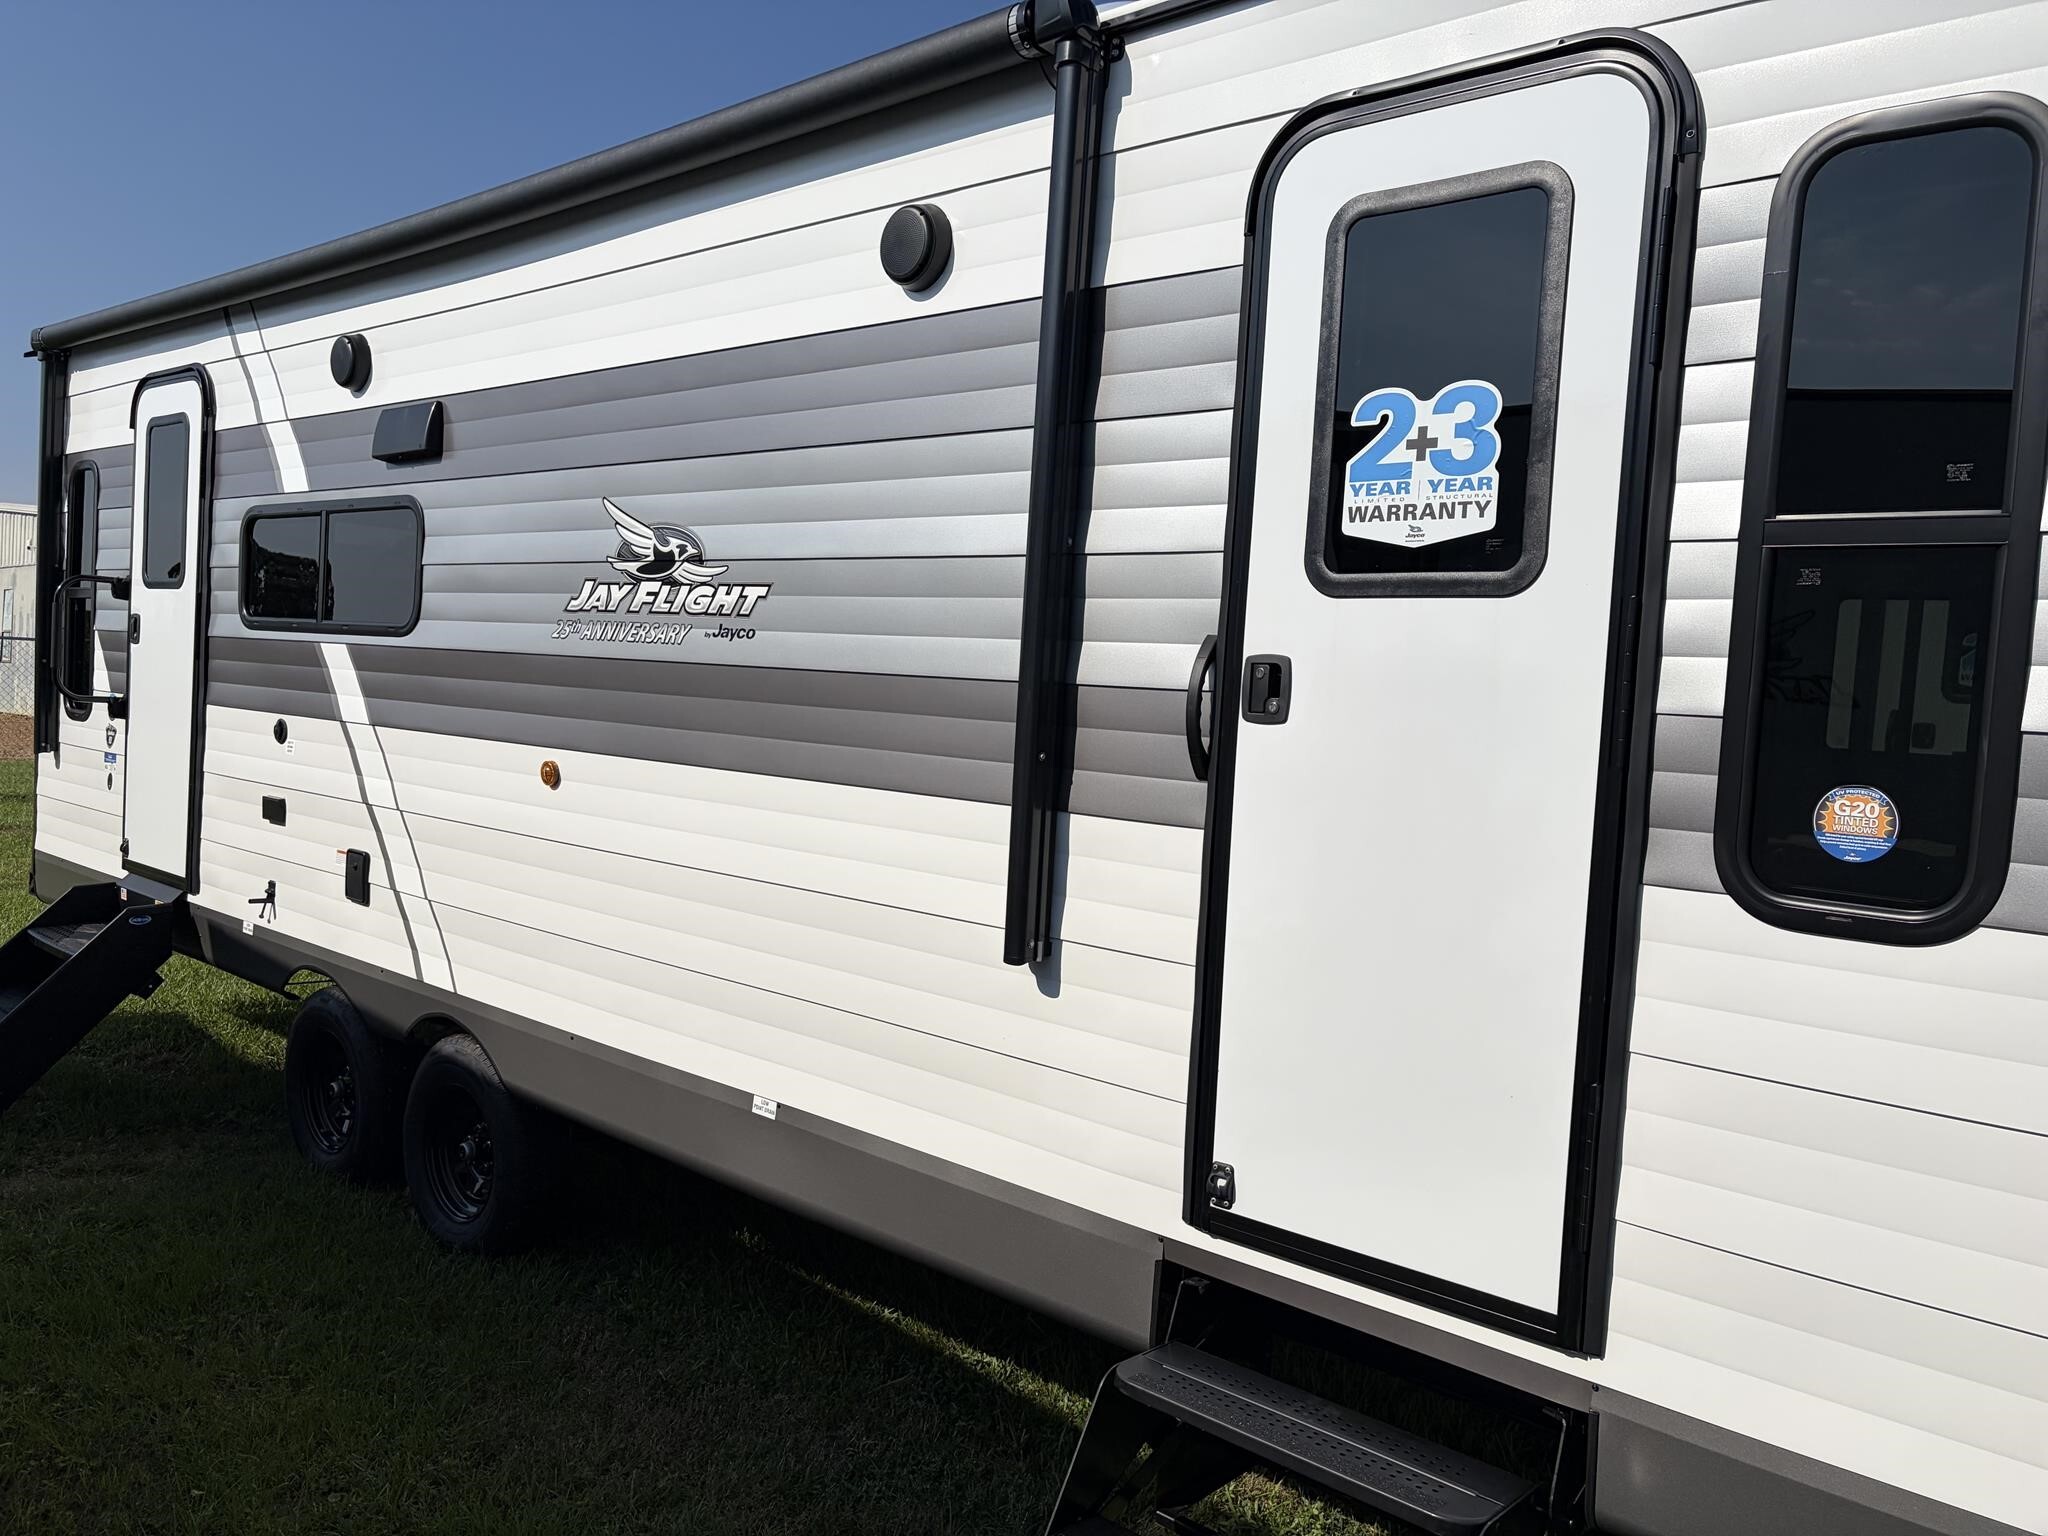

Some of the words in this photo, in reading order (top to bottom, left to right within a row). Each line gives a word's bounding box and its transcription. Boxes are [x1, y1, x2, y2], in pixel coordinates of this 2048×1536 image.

[1350, 480, 1411, 498] YEAR
[1427, 476, 1493, 494] YEAR
[1425, 492, 1494, 501] STRUCTURAL
[1347, 499, 1492, 524] WARRANTY
[551, 618, 583, 640] 25th
[580, 620, 692, 645] ANNIVERSARY
[704, 631, 712, 639] by
[712, 624, 756, 642] Jayco
[1845, 789, 1881, 799] PROTECTED
[1833, 799, 1880, 819] G20
[1832, 824, 1879, 835] WINDOWS
[1833, 815, 1879, 828] TINTED
